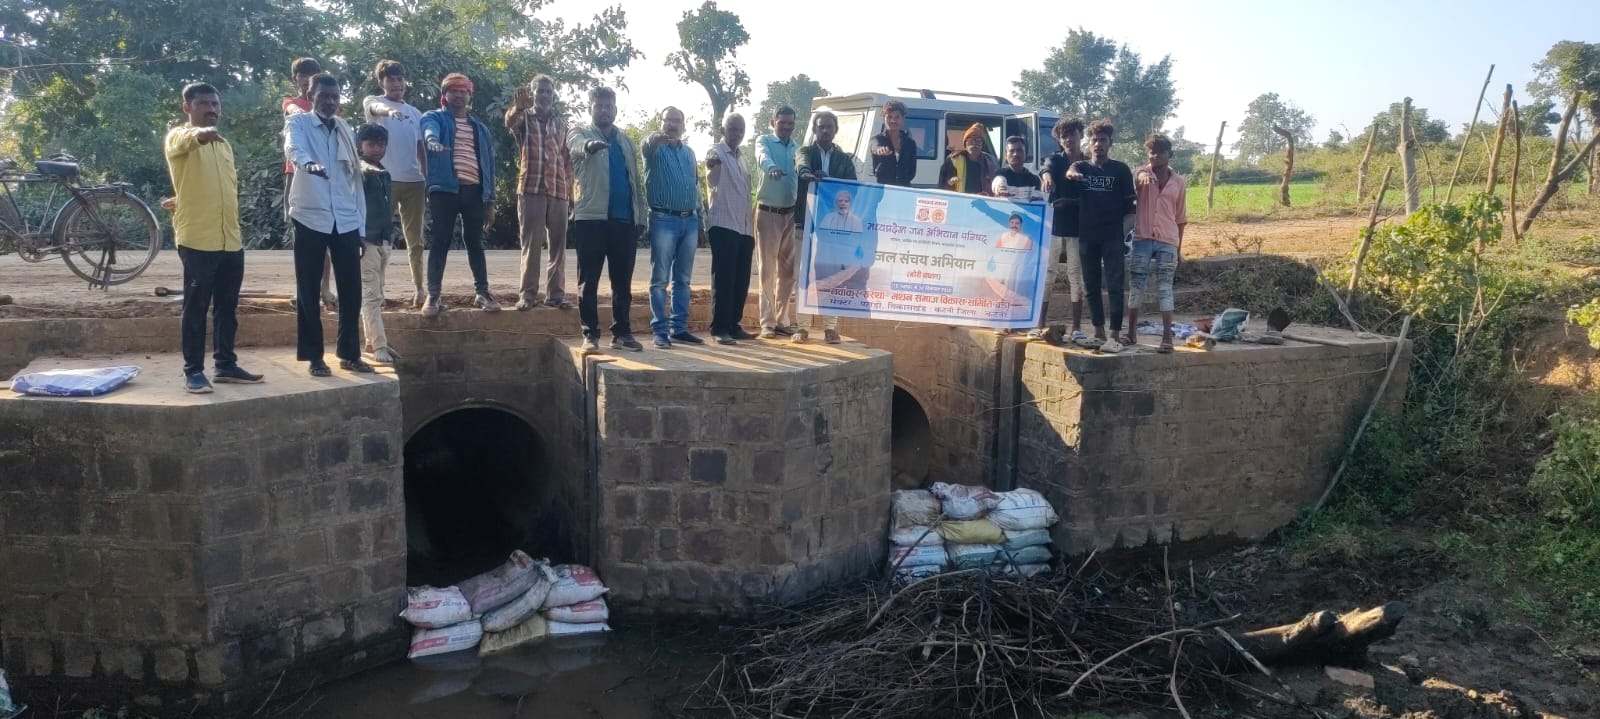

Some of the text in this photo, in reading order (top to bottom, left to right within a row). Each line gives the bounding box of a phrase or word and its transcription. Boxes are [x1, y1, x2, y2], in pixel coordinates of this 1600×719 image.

[867, 222, 907, 235] मध्यप्रदेश
[909, 227, 924, 236] जन
[926, 226, 959, 240] अभियान
[874, 250, 976, 270] जल संचय अभियान
